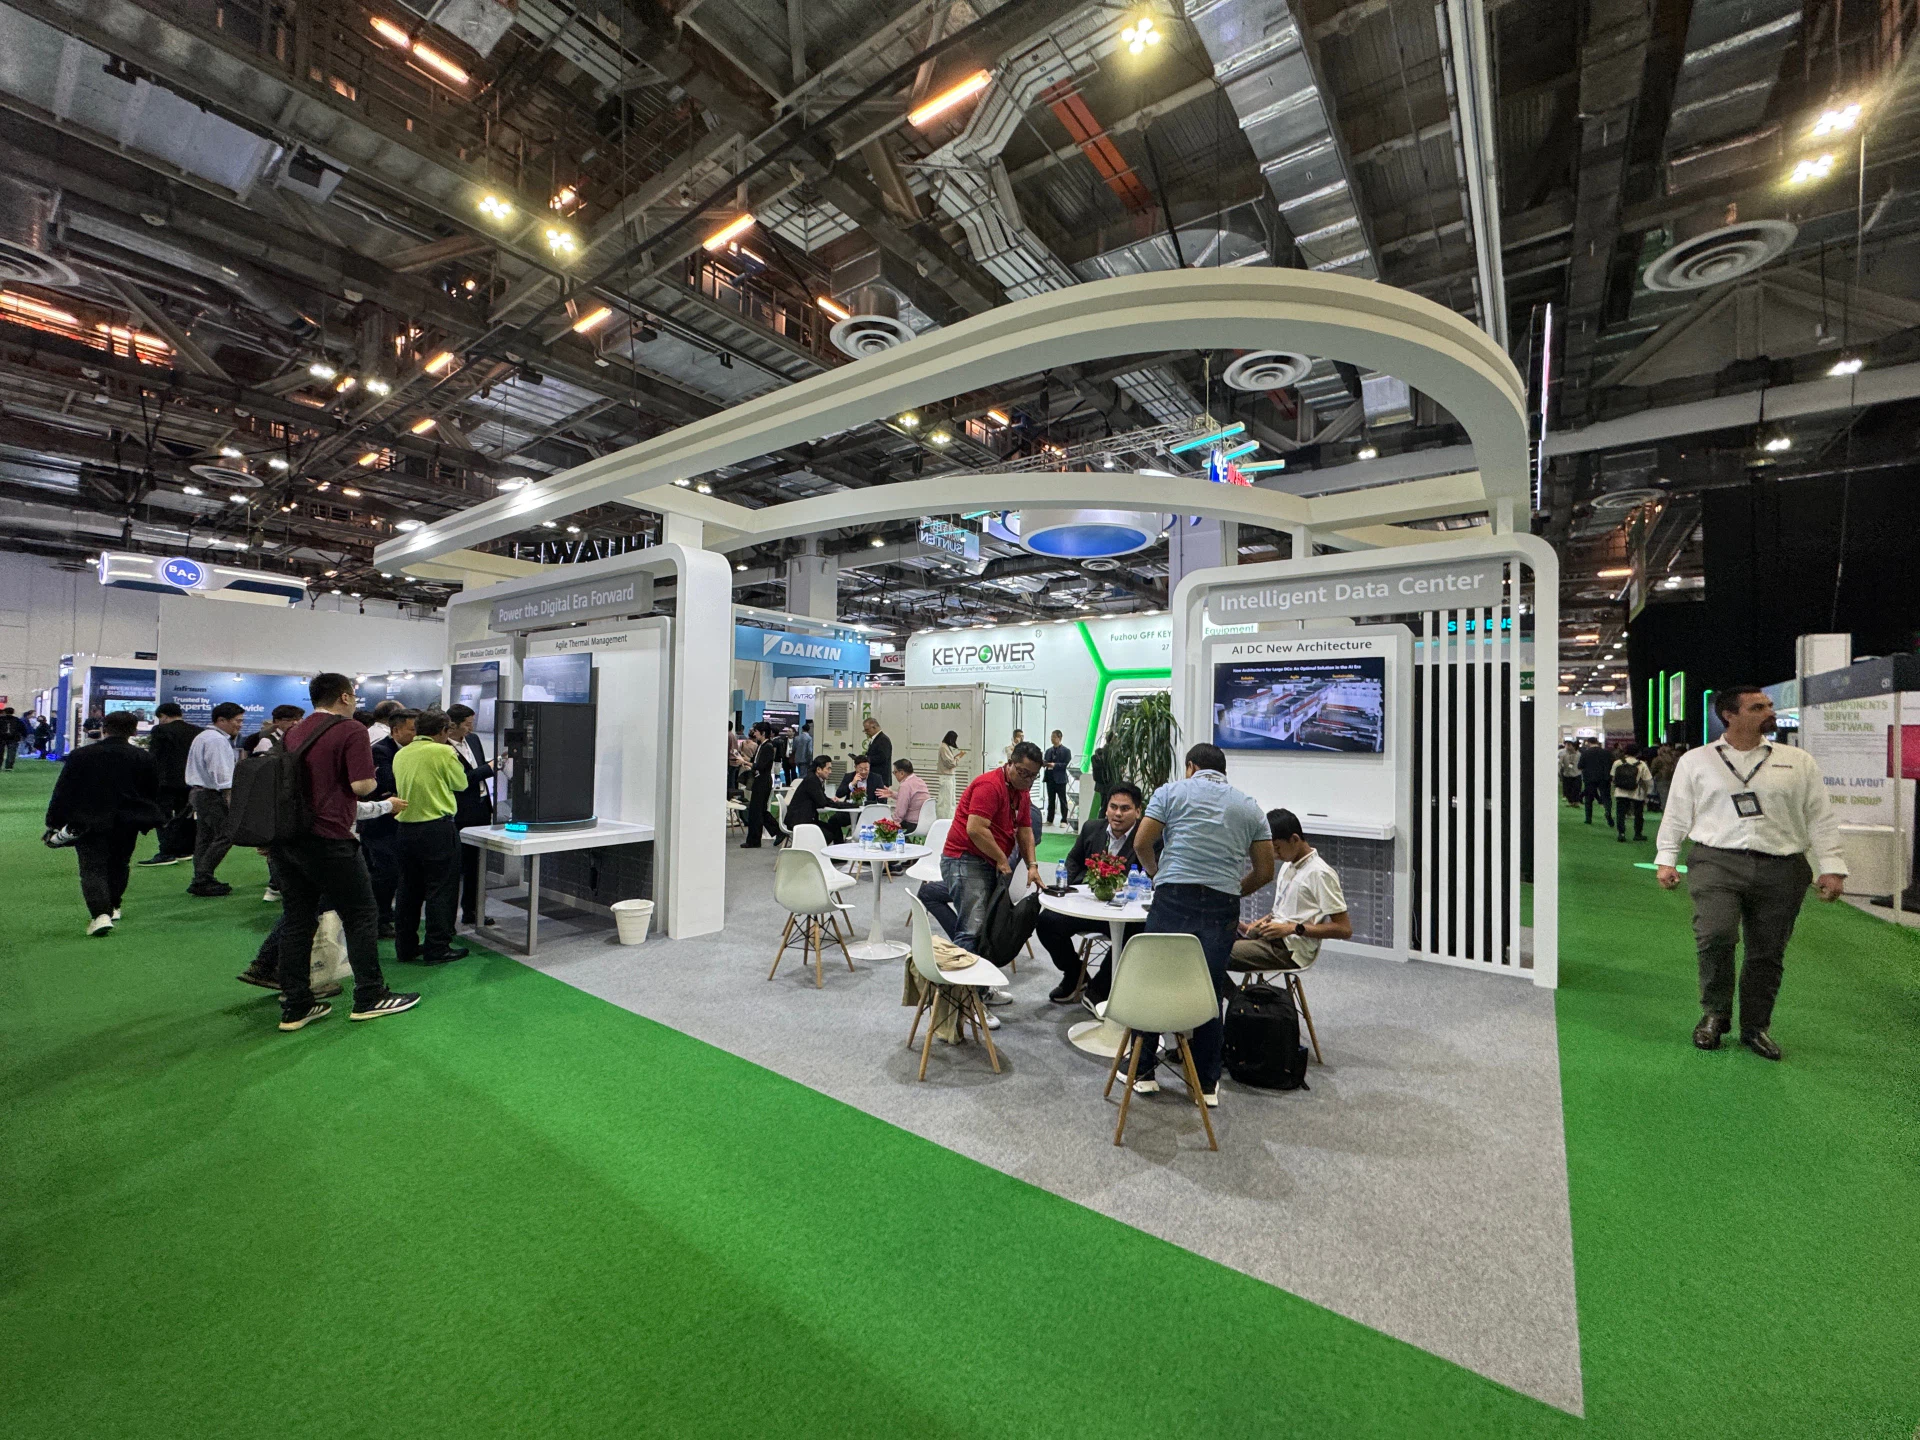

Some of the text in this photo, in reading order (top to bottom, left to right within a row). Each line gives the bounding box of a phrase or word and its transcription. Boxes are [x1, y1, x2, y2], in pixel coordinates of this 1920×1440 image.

[168, 565, 197, 581] BAC
[1221, 574, 1484, 611] Intelligent Data Center
[499, 583, 634, 622] Power the Digital Era Forward
[1110, 633, 1137, 642] Fuzhou
[1140, 631, 1155, 639] GFF
[1205, 625, 1254, 635] Equipment
[555, 634, 627, 651] Agile Thermal Management
[1232, 641, 1372, 654] AI DC New Architecture
[459, 647, 507, 658] Smart Modular Data Center
[780, 641, 841, 661] DAIKIN
[932, 642, 1035, 666] KEYPOWER
[883, 655, 899, 663] AGG
[178, 702, 211, 712] xperts
[920, 702, 961, 710] LOAD BANK
[1824, 722, 1874, 732] SOFTWARE
[1850, 778, 1885, 788] LAYOUT
